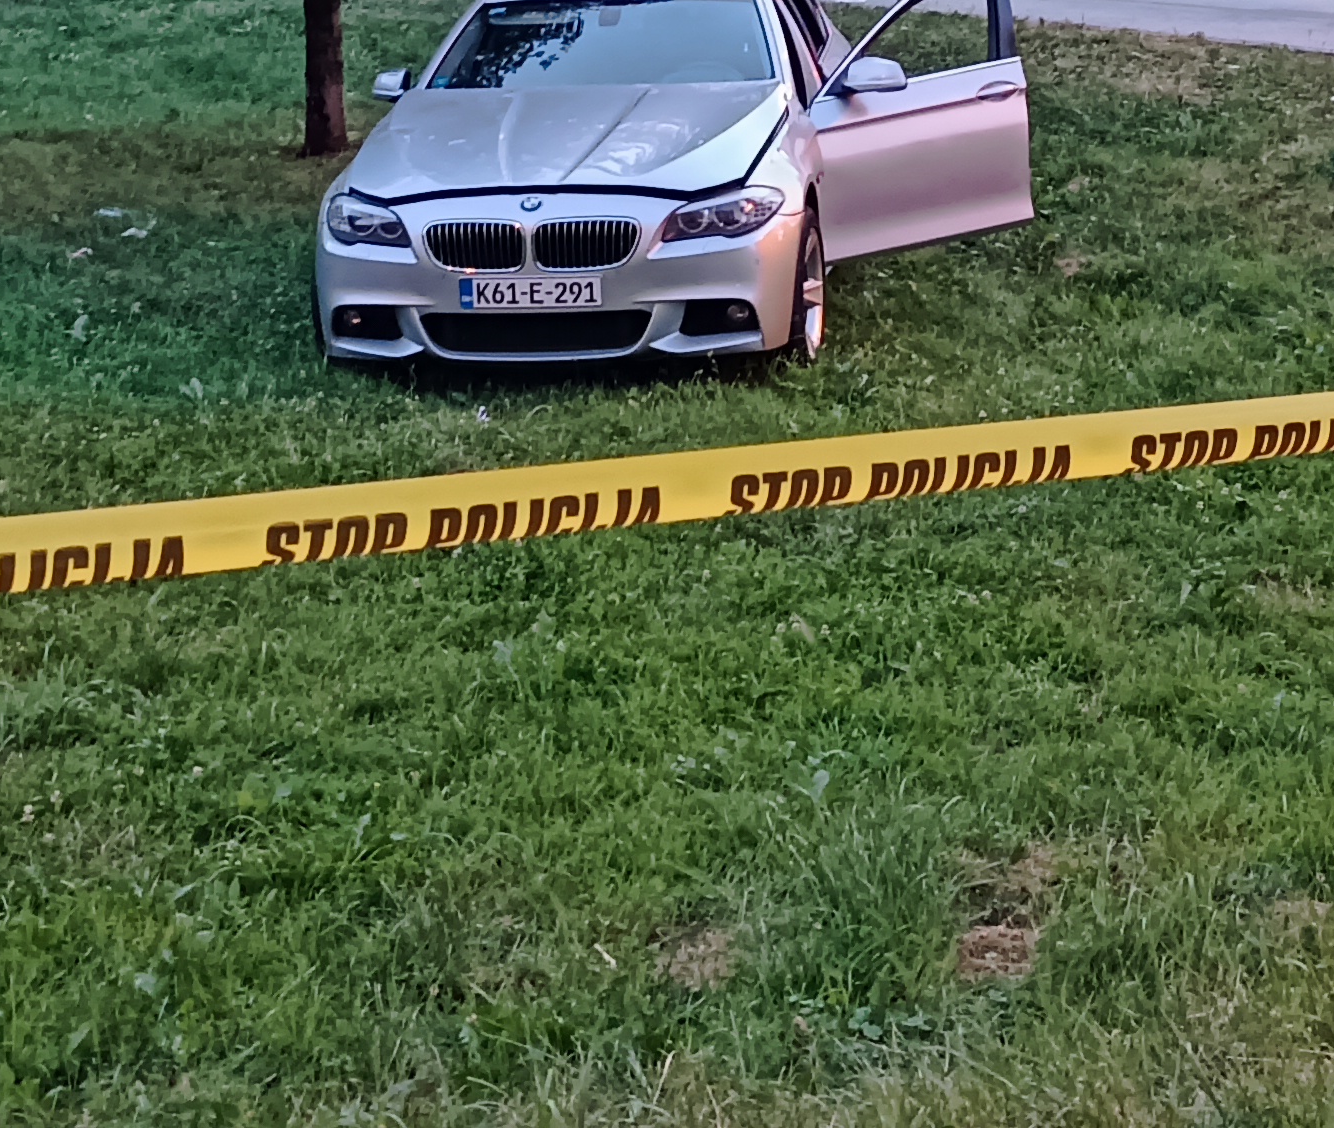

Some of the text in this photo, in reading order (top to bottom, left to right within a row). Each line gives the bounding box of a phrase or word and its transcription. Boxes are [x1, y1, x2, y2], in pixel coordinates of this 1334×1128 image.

[476, 281, 598, 305] K61-E-291
[1127, 428, 1238, 472] STOP
[725, 445, 1071, 516] STOP POLICIJA
[263, 486, 661, 566] STOP POLICIJA
